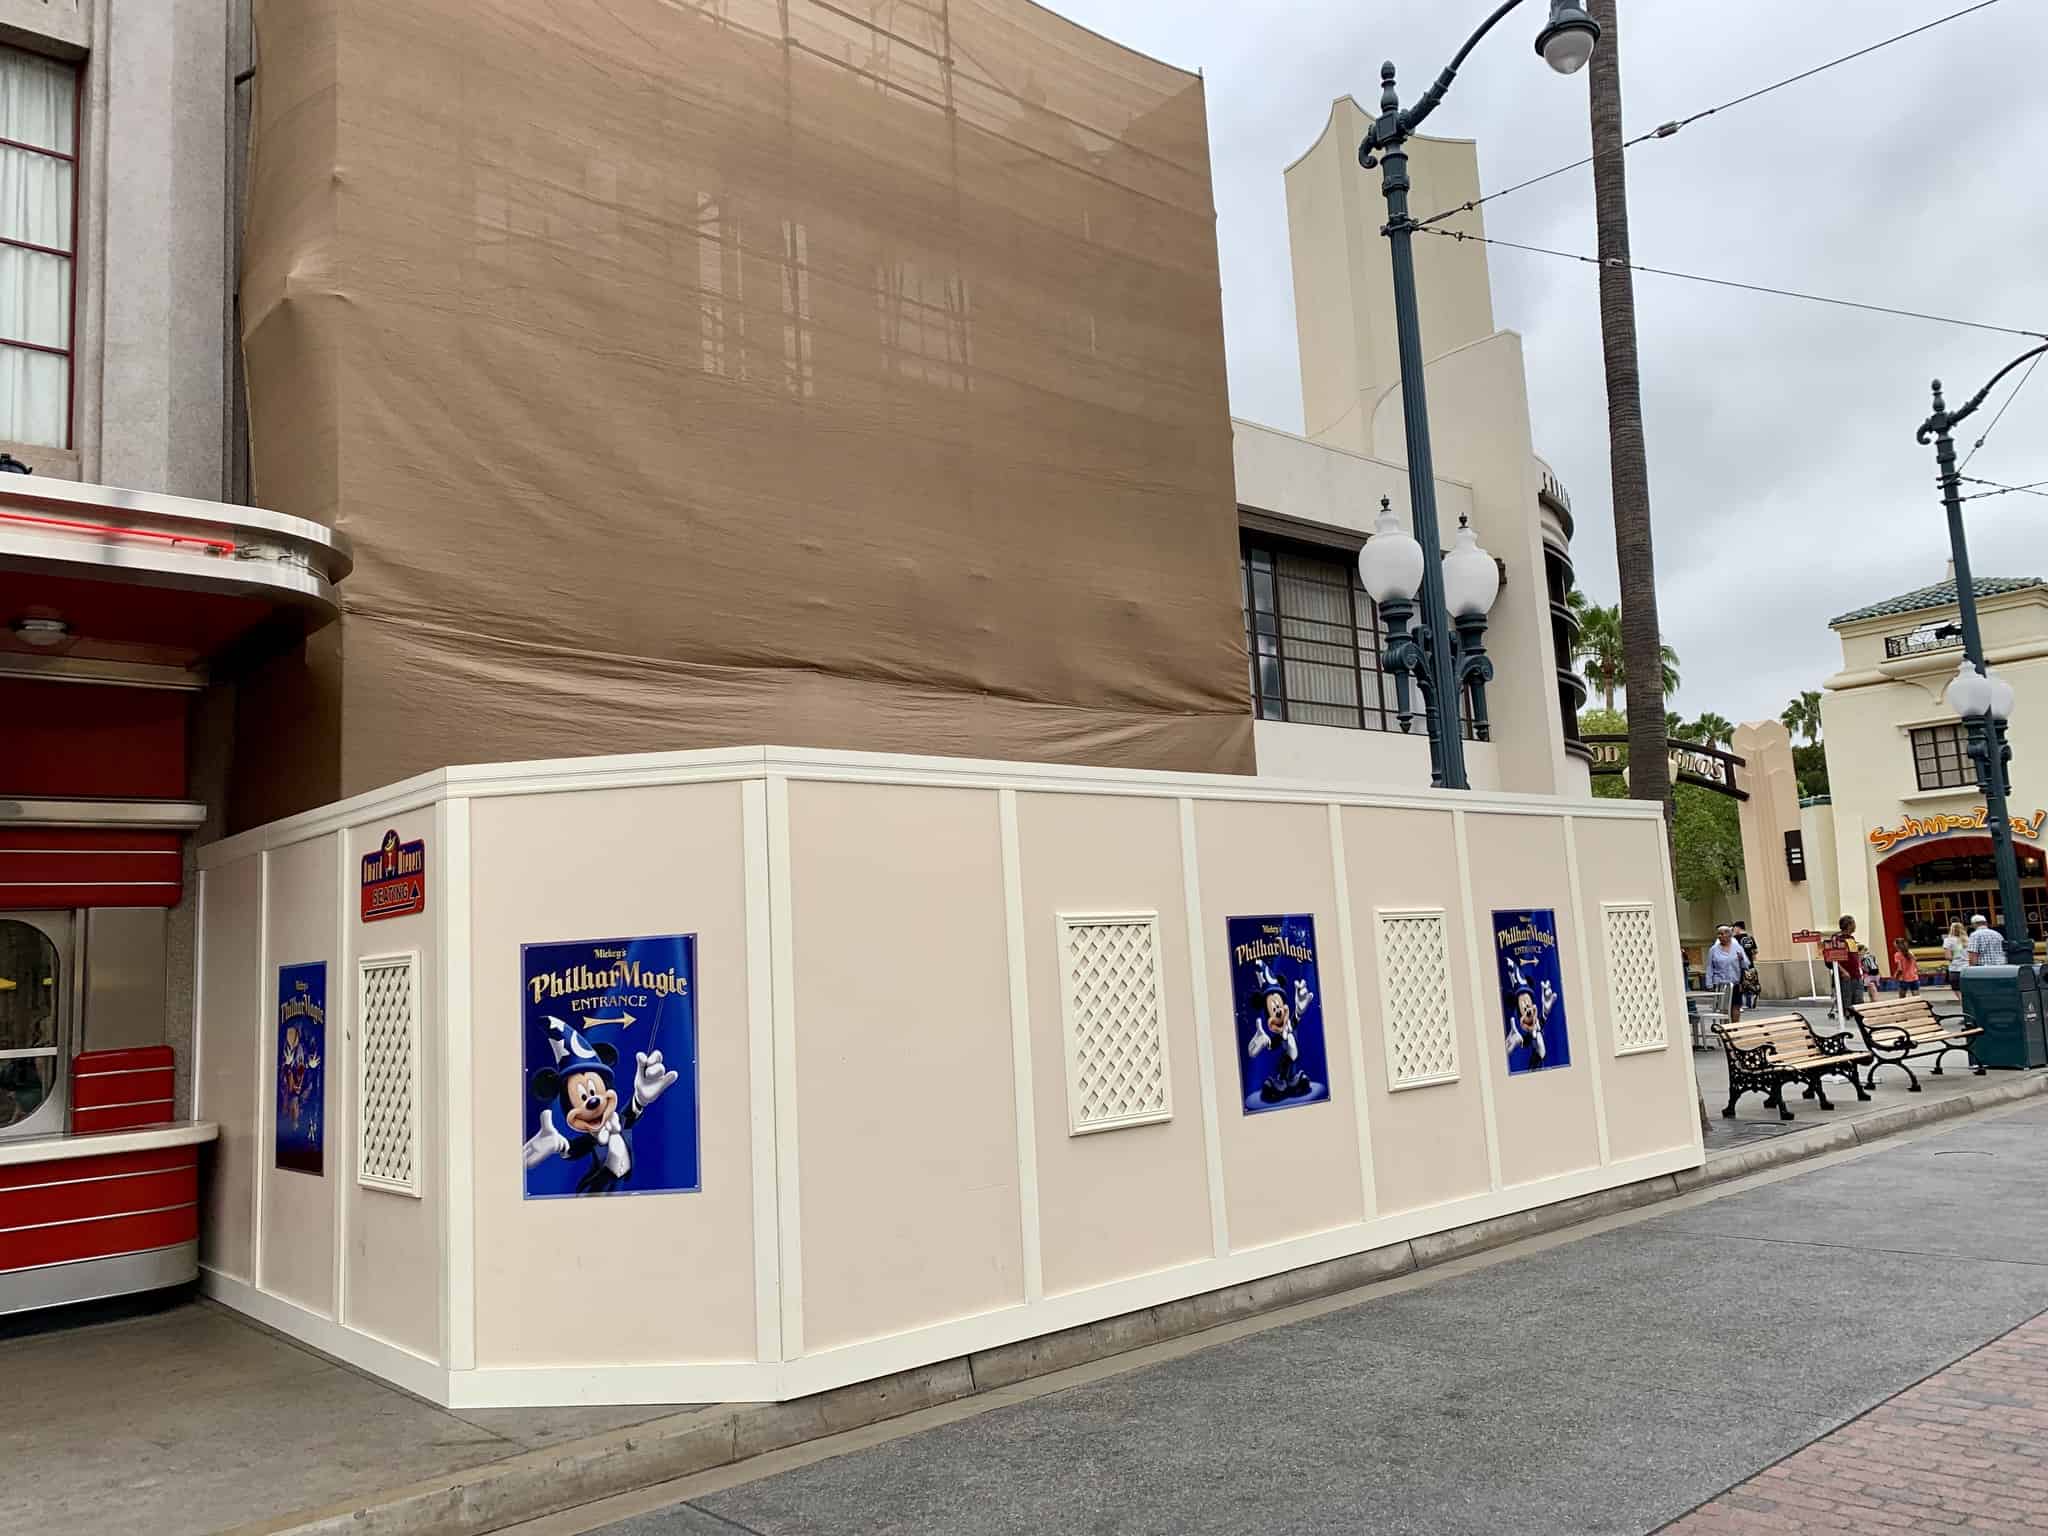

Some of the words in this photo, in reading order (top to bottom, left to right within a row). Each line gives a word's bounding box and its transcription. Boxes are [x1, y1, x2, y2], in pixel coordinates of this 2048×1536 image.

[372, 882, 409, 906] SEATING
[1235, 936, 1313, 967] PhilharMagic
[527, 960, 689, 1004] PhilharMagic
[571, 994, 648, 1012] ENTRANCE
